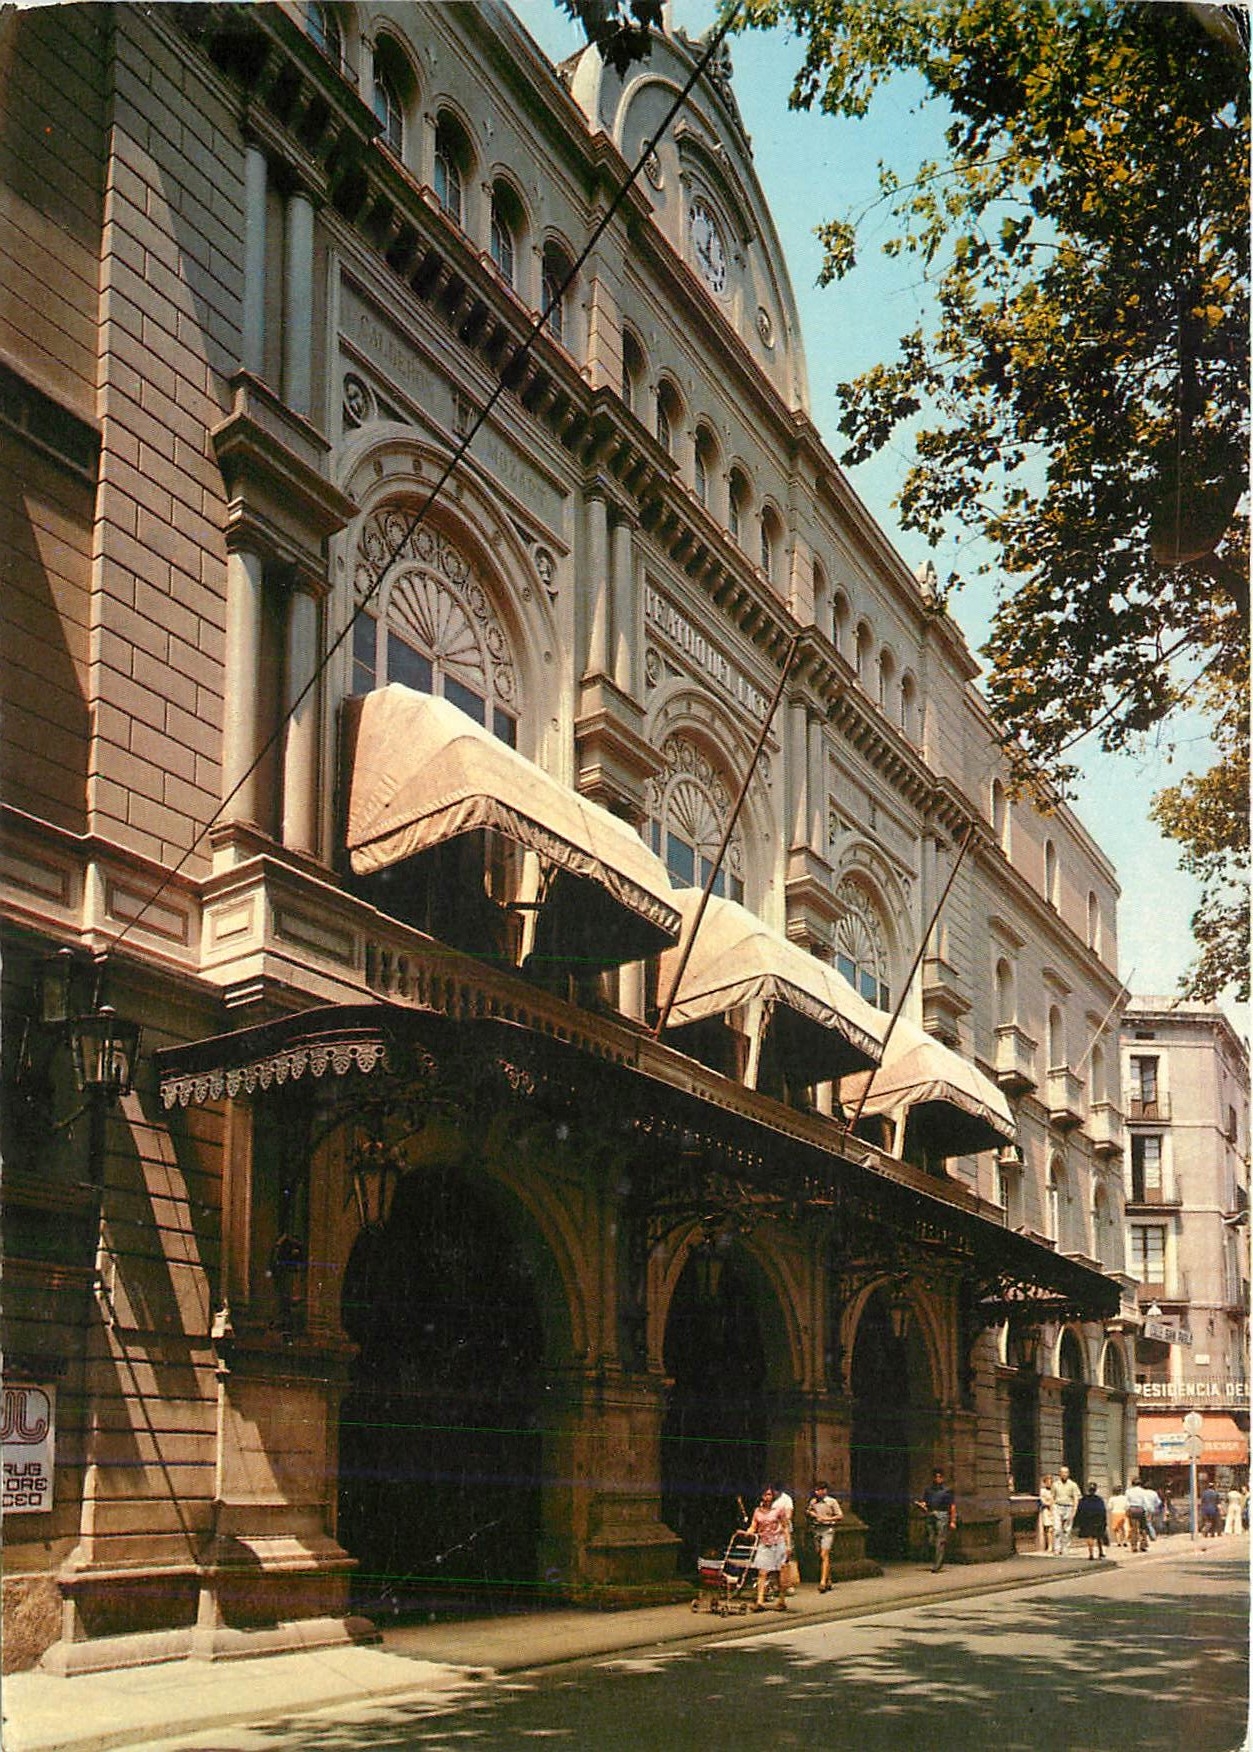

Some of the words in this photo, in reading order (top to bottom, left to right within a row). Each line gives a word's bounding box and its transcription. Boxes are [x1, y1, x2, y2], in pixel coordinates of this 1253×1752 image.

[738, 676, 772, 725] LICE
[1134, 1383, 1220, 1397] RESIDENCIA
[4, 1477, 48, 1491] ORE
